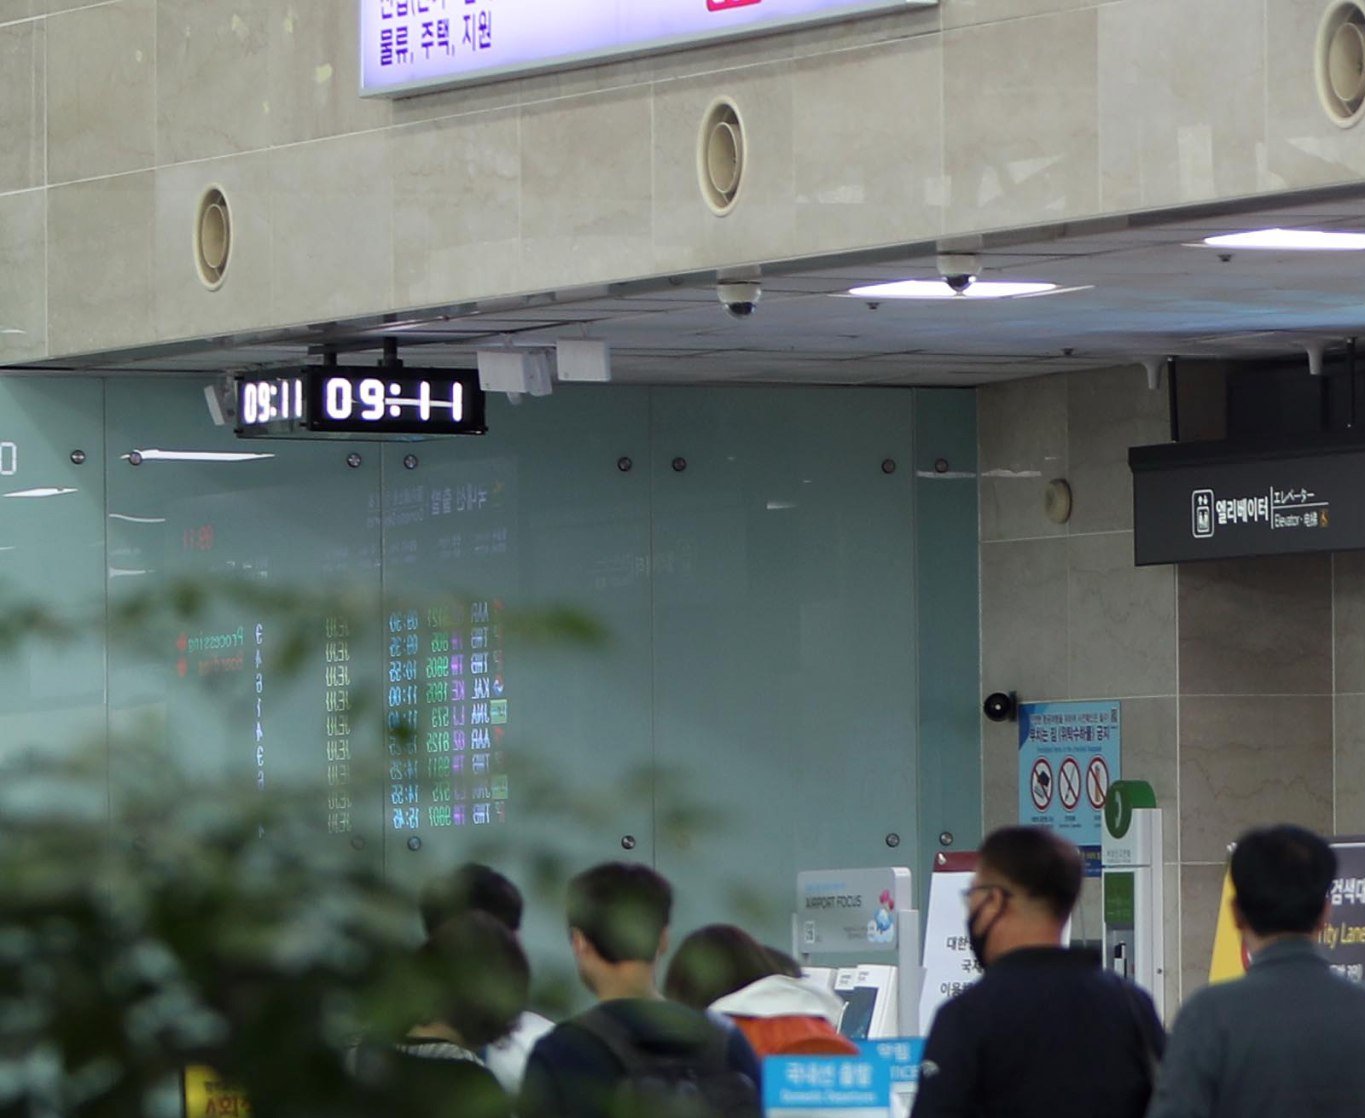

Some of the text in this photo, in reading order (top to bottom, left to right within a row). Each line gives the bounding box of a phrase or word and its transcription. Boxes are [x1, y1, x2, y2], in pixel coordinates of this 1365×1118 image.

[380, 10, 492, 66] 물류, 주택, 지원
[243, 378, 303, 425] 09:11
[326, 377, 463, 422] 09:11
[1216, 496, 1269, 525] 엘리베이터
